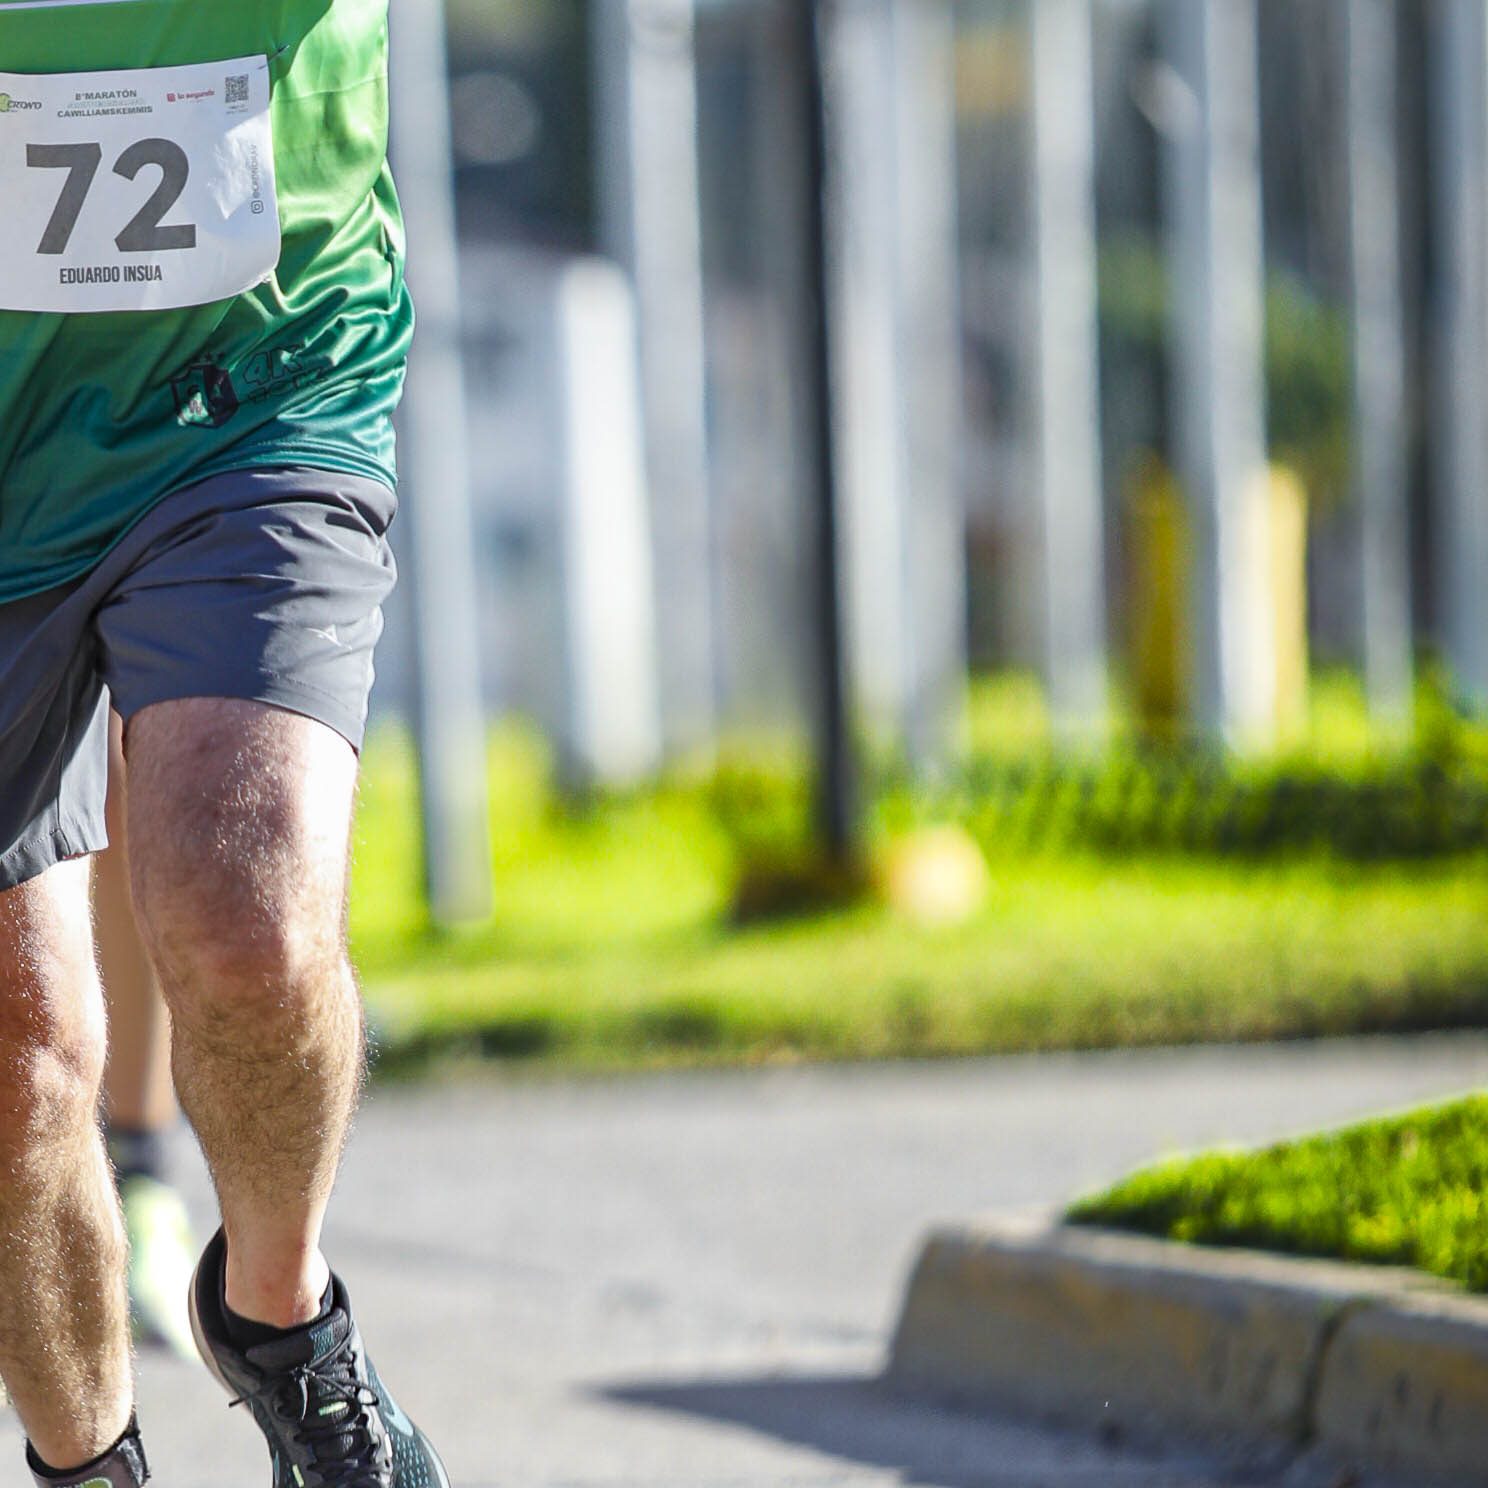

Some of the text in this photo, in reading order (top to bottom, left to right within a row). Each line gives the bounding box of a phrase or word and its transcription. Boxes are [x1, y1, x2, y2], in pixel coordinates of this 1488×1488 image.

[25, 137, 197, 255] 72
[59, 264, 163, 285] EDUARDO INSUA
